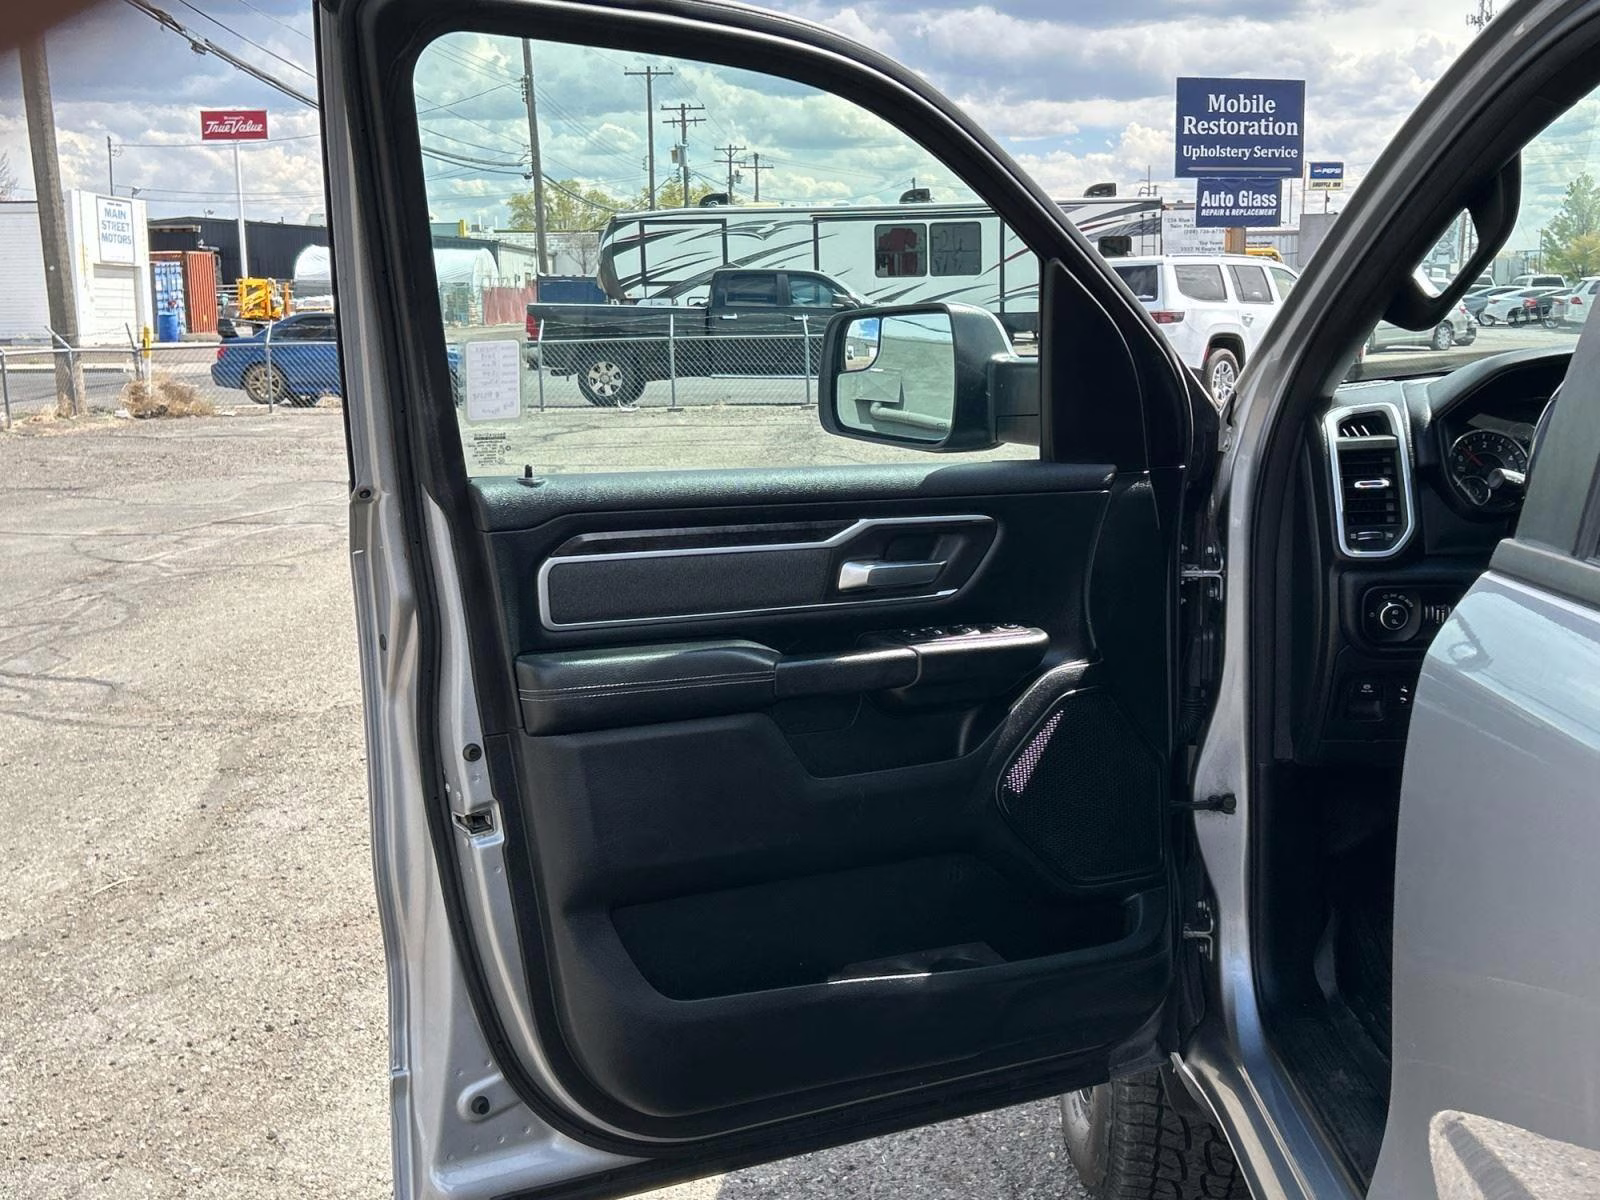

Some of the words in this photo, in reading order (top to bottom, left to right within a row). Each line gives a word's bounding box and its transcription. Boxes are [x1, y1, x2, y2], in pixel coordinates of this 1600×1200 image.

[1207, 94, 1276, 114] Mobile
[1183, 116, 1299, 136] Restoration
[1183, 144, 1251, 161] Upholstery
[1253, 145, 1299, 159] Service
[1200, 190, 1233, 208] Auto
[1238, 190, 1277, 208] Glass
[104, 208, 127, 220] MAIN
[1201, 208, 1224, 216] REPAIR
[1231, 208, 1277, 216] REPLACEMENT
[102, 220, 130, 232] STREET
[101, 232, 132, 245] MOTORS
